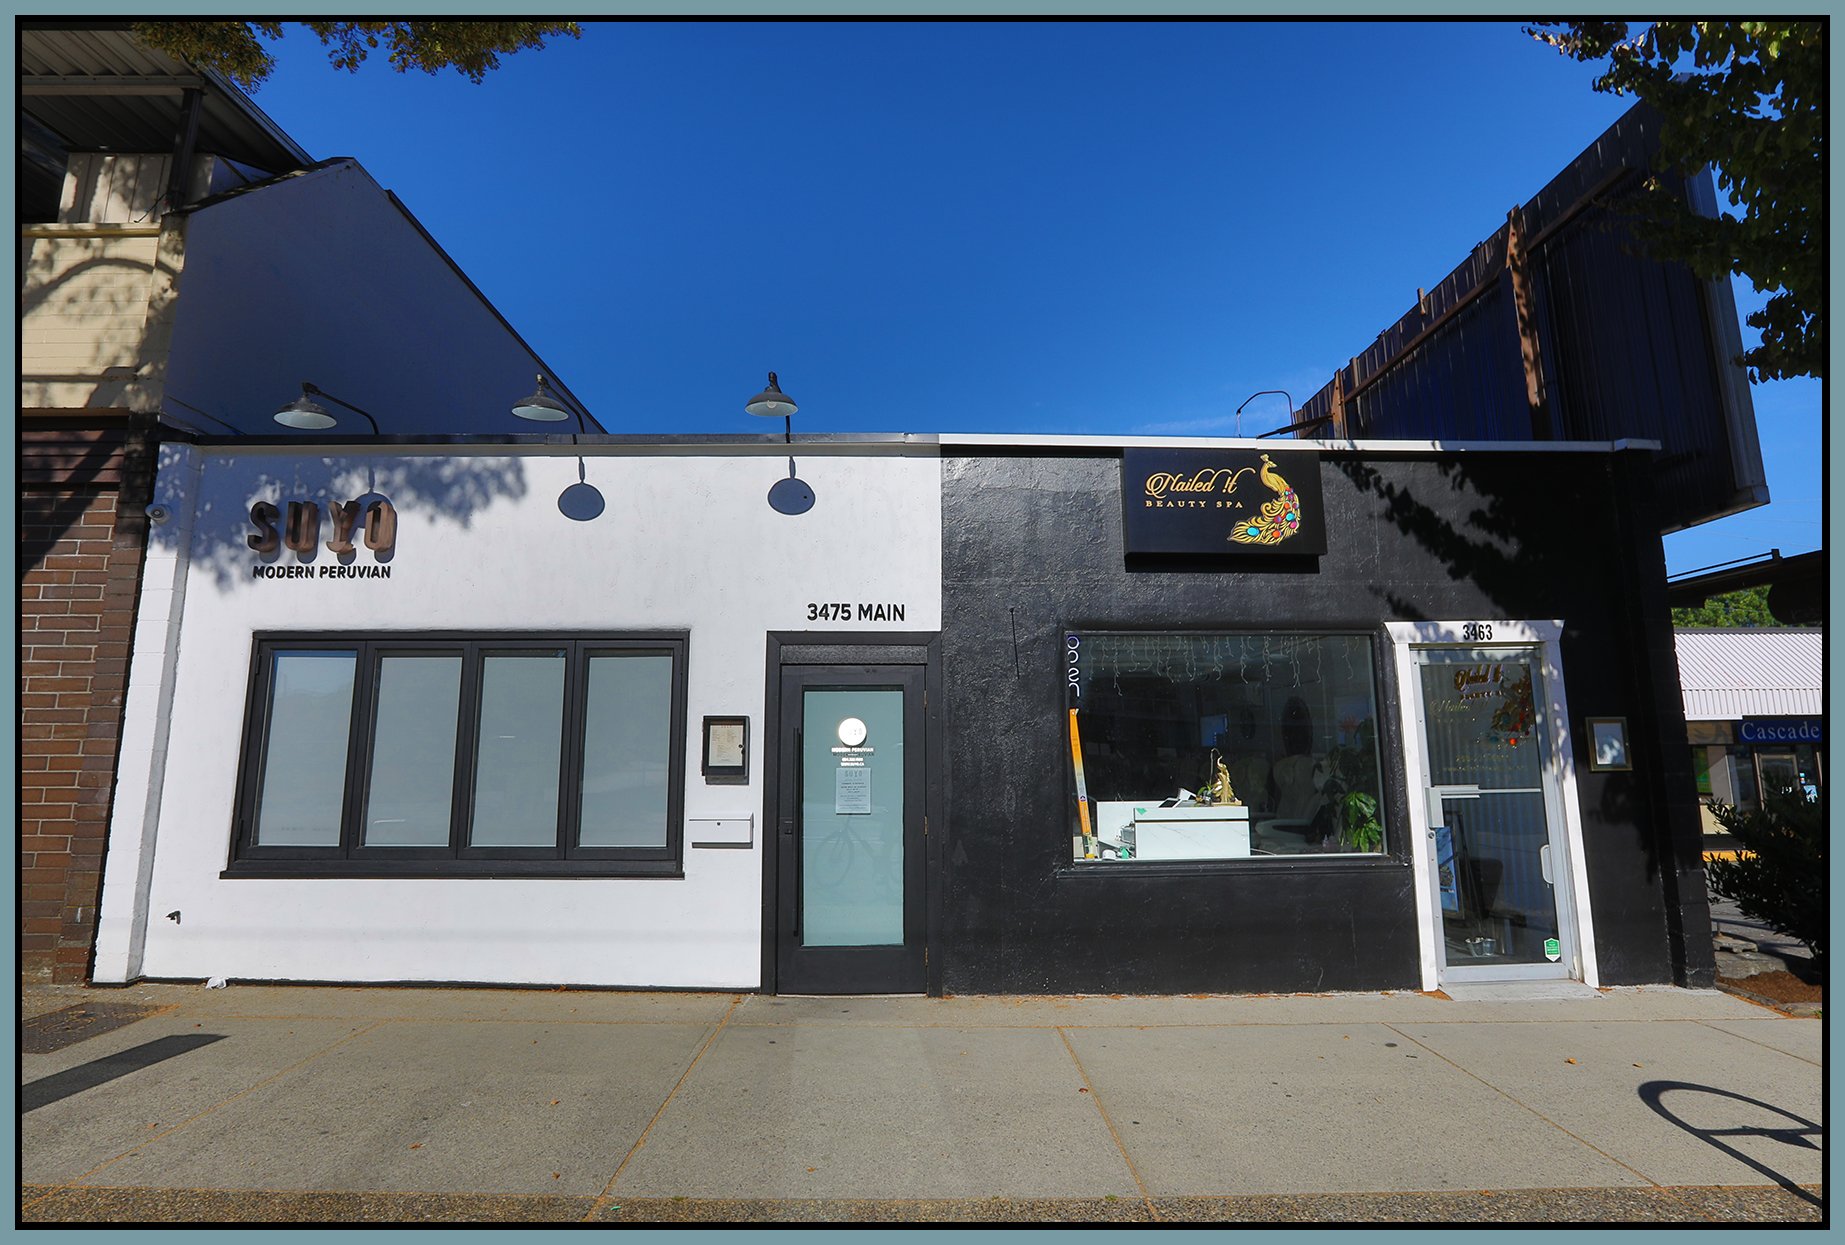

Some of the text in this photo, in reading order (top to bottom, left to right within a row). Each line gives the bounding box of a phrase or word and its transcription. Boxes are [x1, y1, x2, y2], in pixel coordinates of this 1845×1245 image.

[1145, 468, 1232, 499] Nailed
[1146, 500, 1244, 508] BEAUTY SPA
[247, 500, 397, 554] SUYO
[252, 566, 391, 579] MODERN PERUVIAN
[807, 603, 905, 621] 3475 MAIN
[1462, 624, 1493, 640] 3463
[1741, 721, 1820, 740] Cascade
